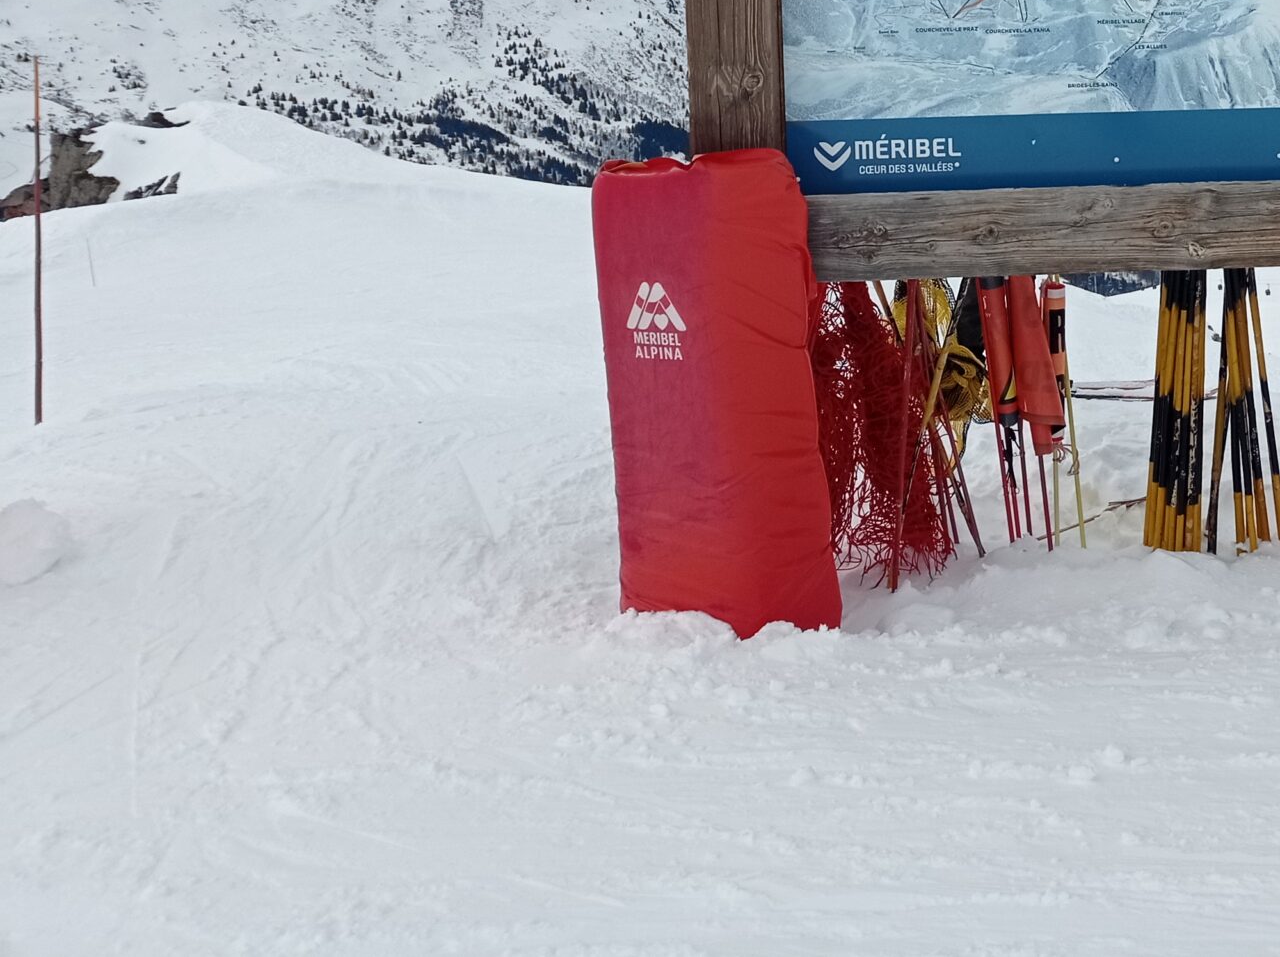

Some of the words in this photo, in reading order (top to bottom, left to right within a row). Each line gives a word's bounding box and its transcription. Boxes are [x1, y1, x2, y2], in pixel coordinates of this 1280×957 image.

[854, 134, 962, 160] MÉRIBEL
[859, 165, 887, 174] CŒUR
[888, 164, 907, 174] DES
[908, 163, 914, 173] 3
[916, 160, 954, 173] VALLÉES
[633, 331, 682, 346] MERIBEL
[635, 346, 683, 361] ALPINA
